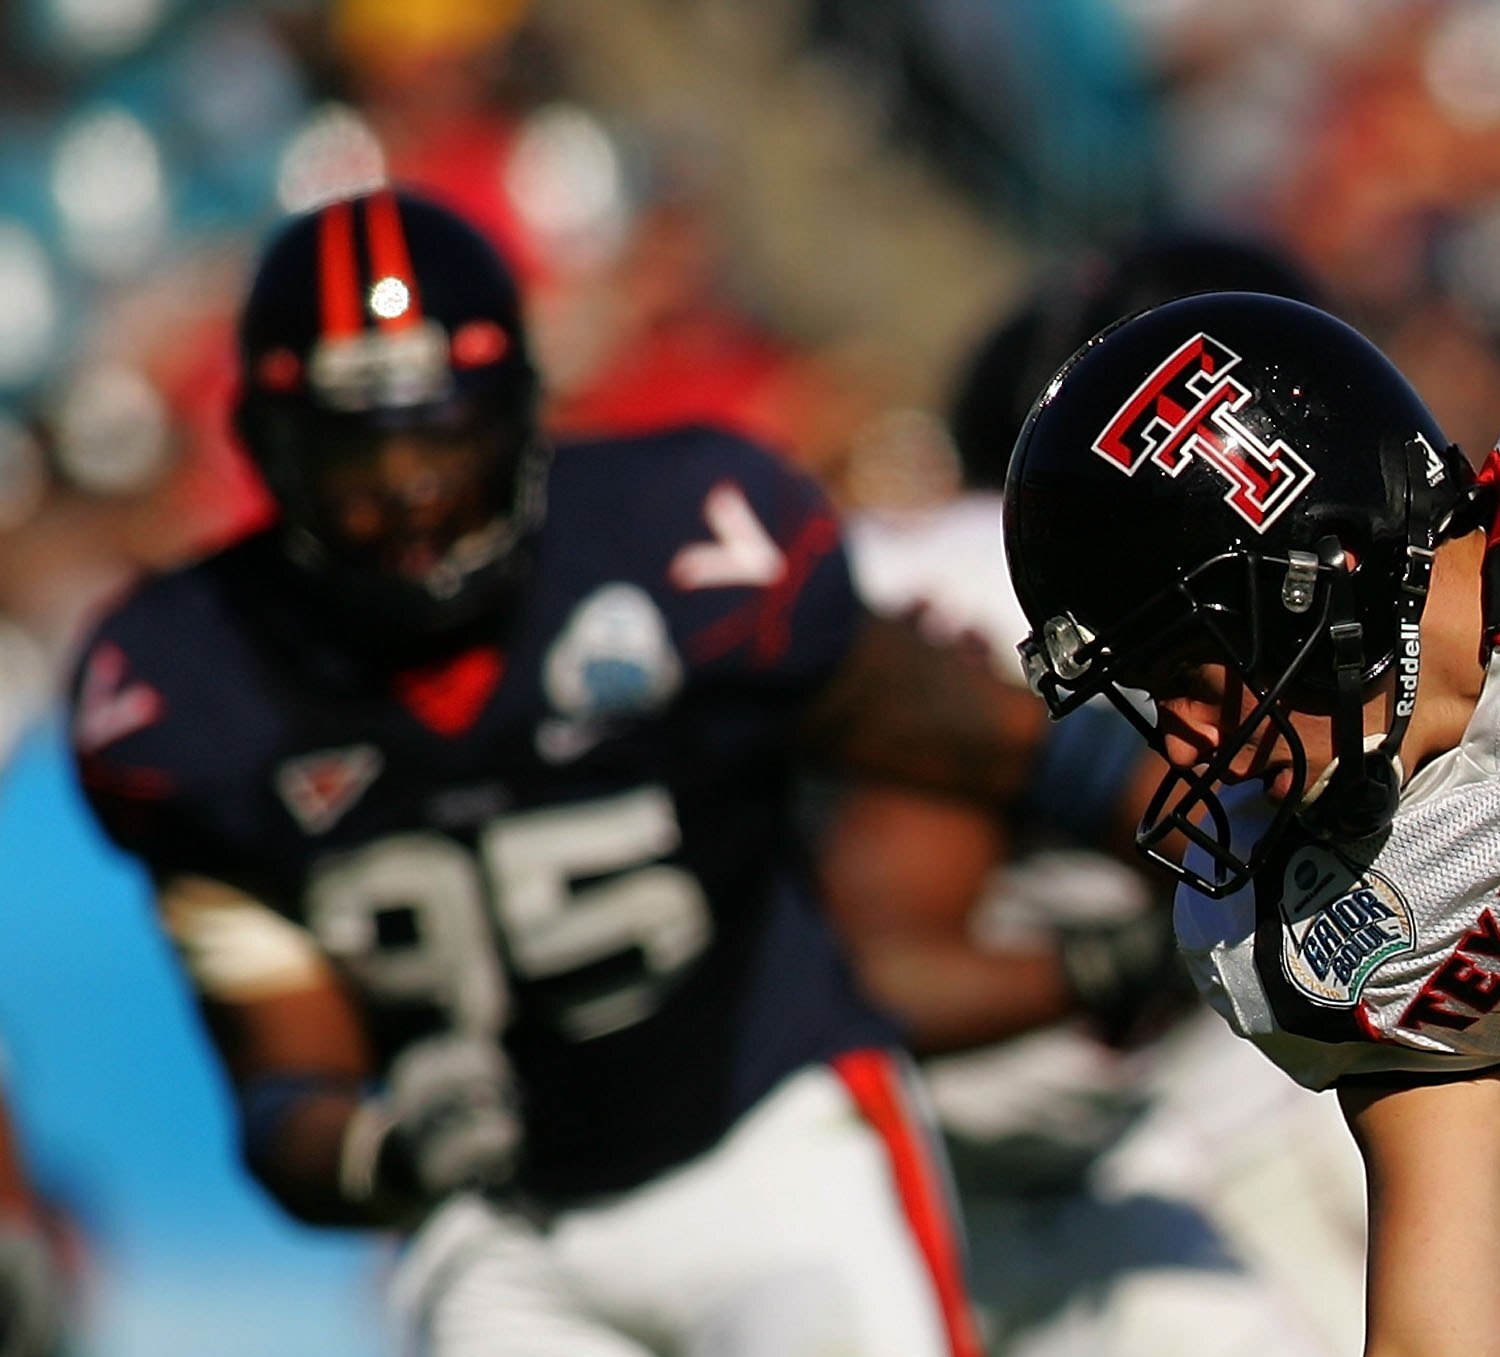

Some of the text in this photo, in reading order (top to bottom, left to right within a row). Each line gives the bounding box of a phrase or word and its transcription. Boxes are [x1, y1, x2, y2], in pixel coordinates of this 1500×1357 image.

[1397, 622, 1420, 718] Riddell
[306, 784, 714, 1043] 95
[1303, 886, 1397, 982] GATOR
[1332, 923, 1402, 987] BOWL
